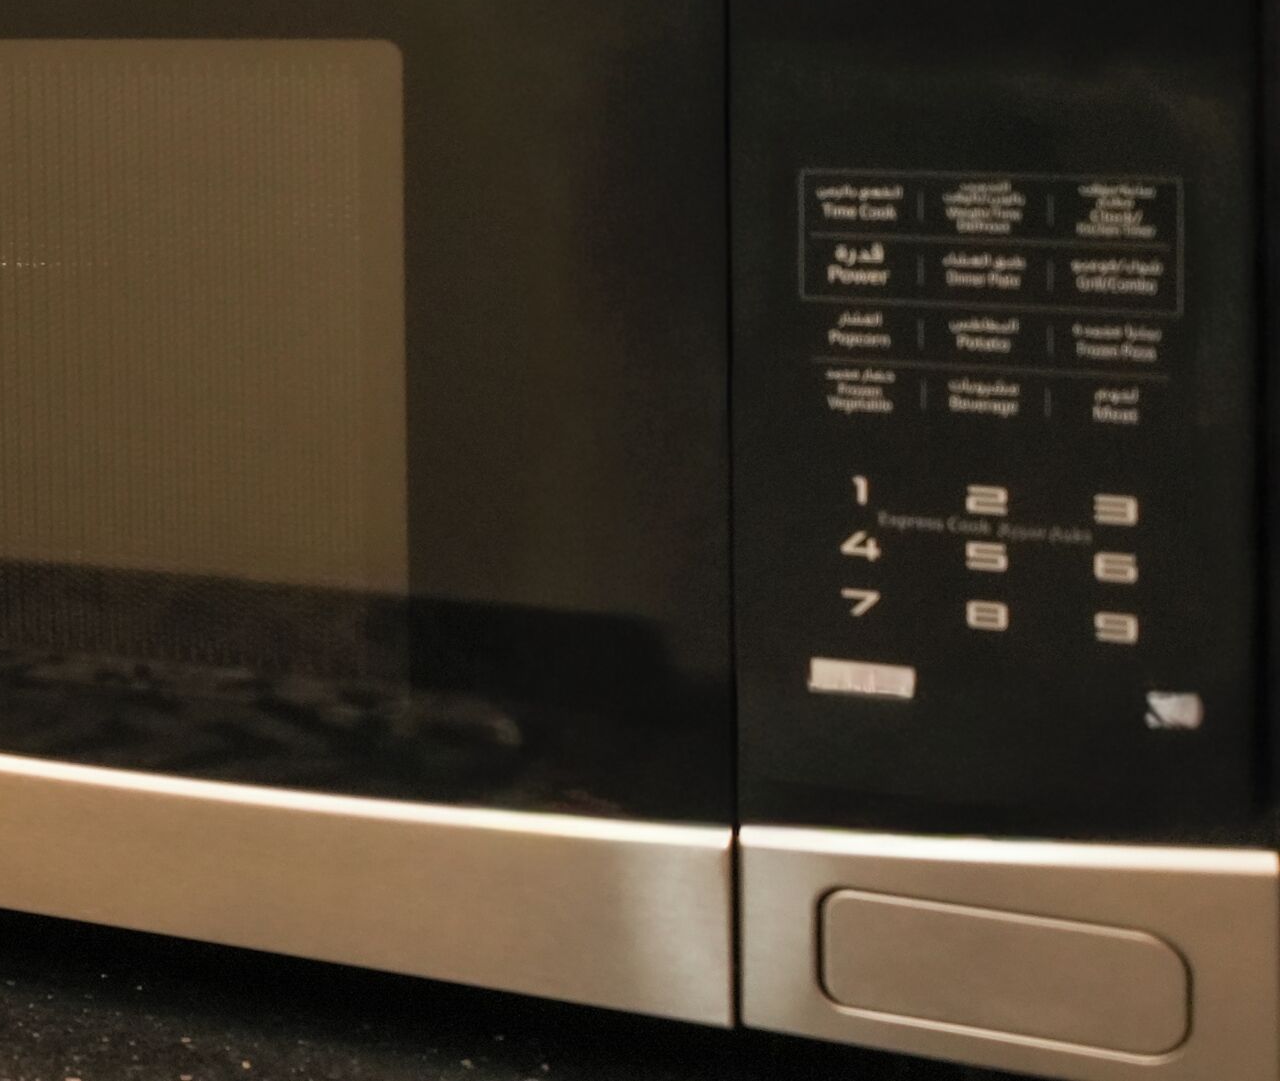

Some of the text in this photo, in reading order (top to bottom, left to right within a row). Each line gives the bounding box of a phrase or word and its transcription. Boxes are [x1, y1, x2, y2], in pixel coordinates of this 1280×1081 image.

[821, 201, 897, 221] Time Cook
[827, 264, 891, 286] Power
[828, 328, 891, 350] Popcorn
[956, 333, 1011, 354] Potato
[852, 474, 869, 507] 1
[965, 483, 1009, 516] 2
[1093, 493, 1139, 527] 3
[840, 530, 881, 562] 4
[965, 541, 1009, 572] 5
[1093, 551, 1139, 585] 6
[841, 587, 881, 617] 7
[965, 600, 1009, 631] 8
[1093, 611, 1139, 644] 9
